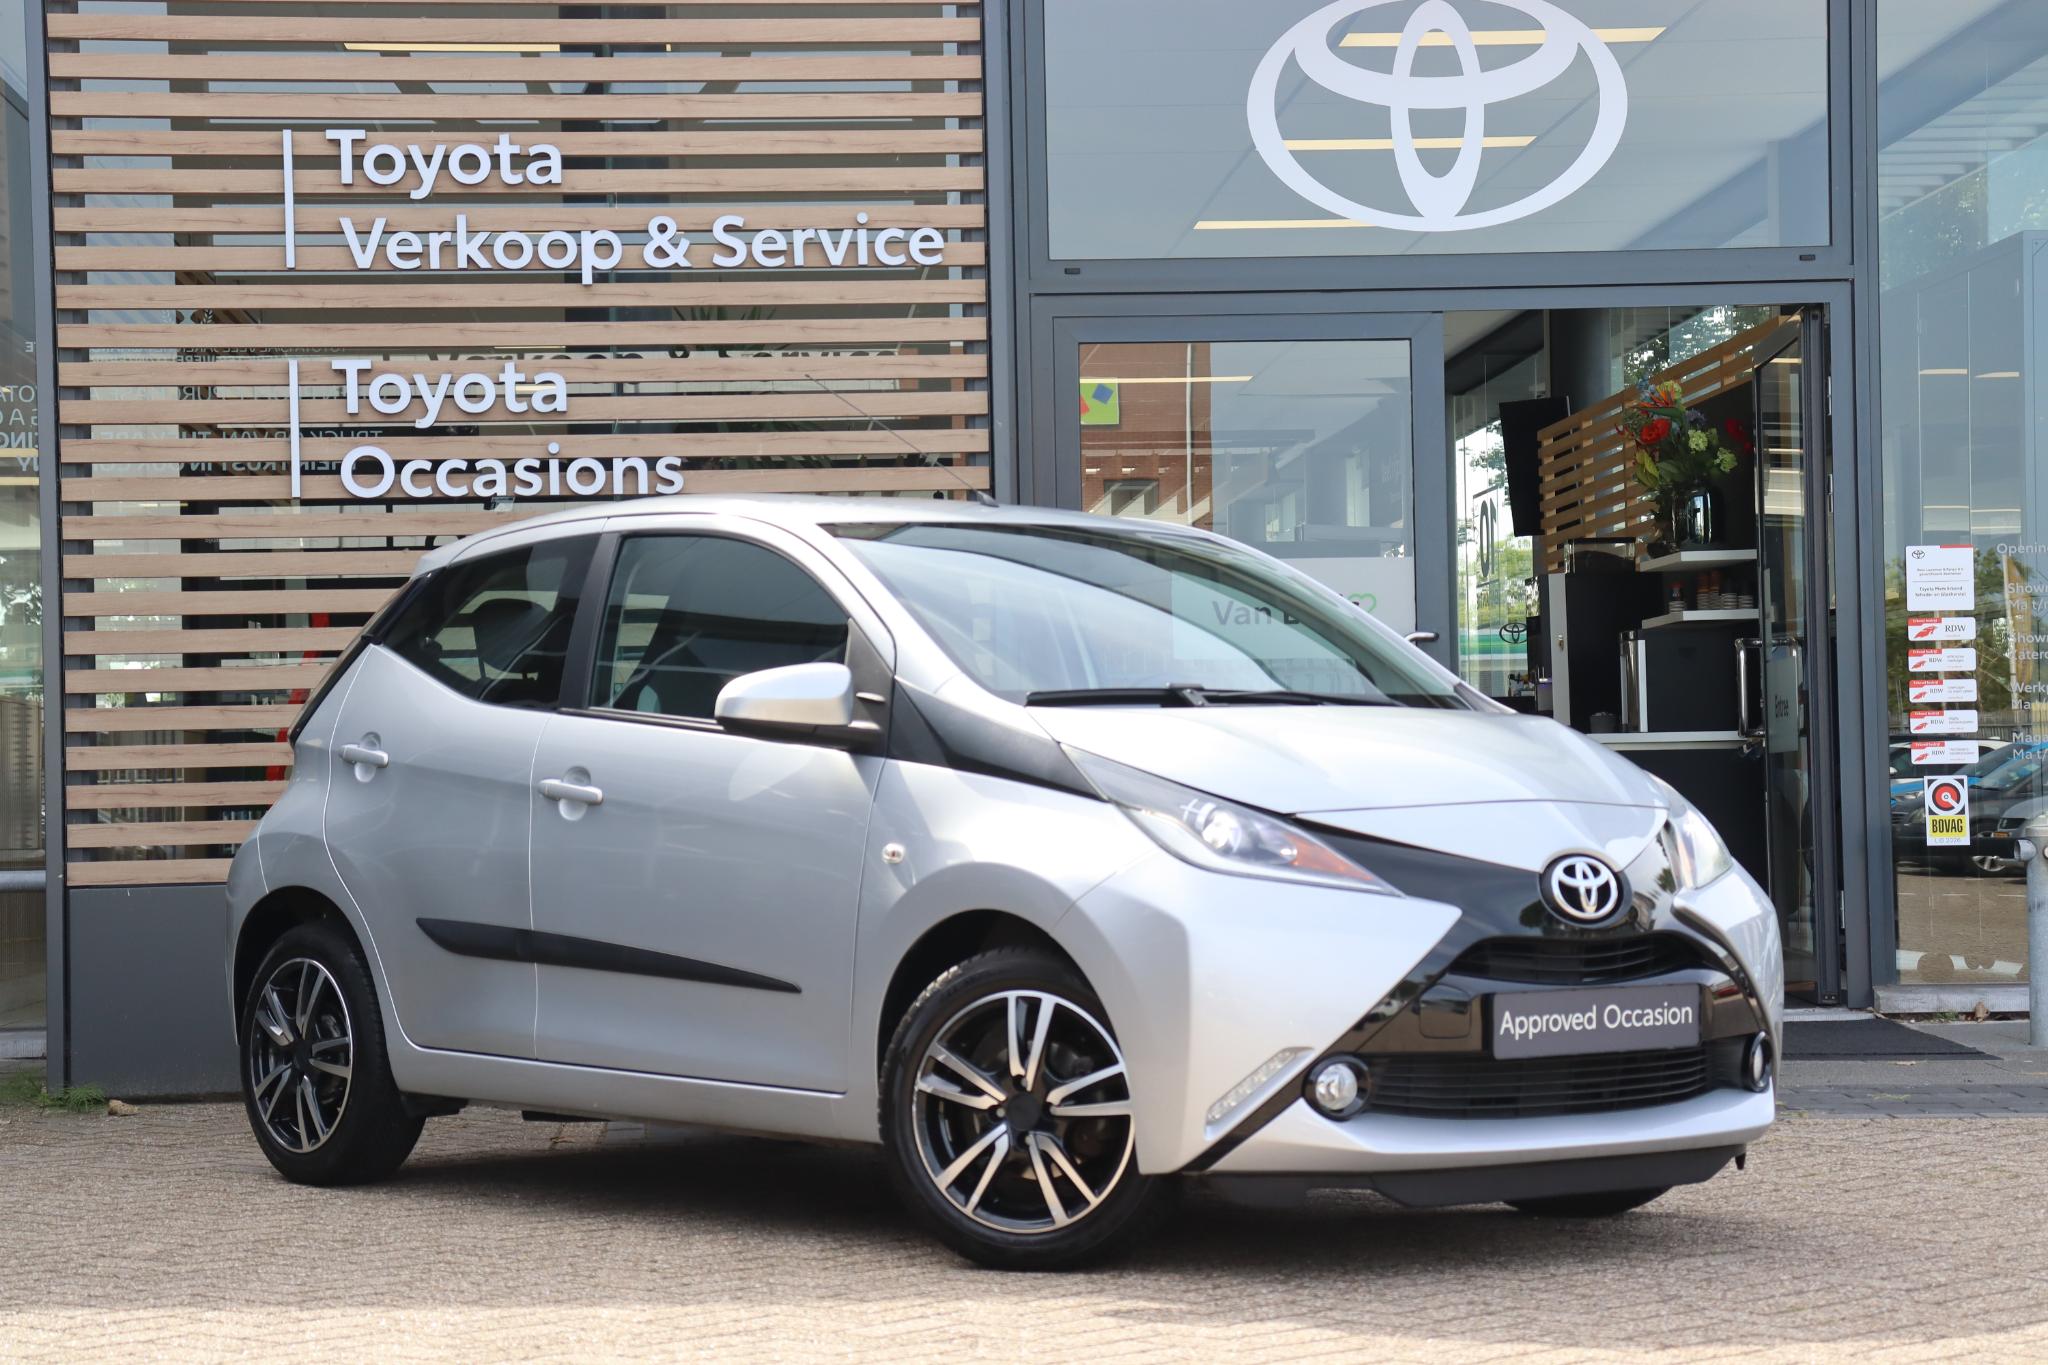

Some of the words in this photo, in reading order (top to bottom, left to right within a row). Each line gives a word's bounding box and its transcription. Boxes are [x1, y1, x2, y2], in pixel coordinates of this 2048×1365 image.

[325, 128, 563, 200] Toyota
[339, 213, 623, 286] Verkoop
[643, 214, 689, 268] &
[710, 211, 945, 269] Service
[331, 359, 569, 429] Toyota
[340, 441, 685, 500] Occasions
[1212, 600, 1272, 625] Van
[1945, 624, 1966, 632] RDW
[1931, 818, 1963, 833] BOVAG
[1500, 1005, 1597, 1040] Approved
[1603, 1002, 1693, 1029] Occasion
